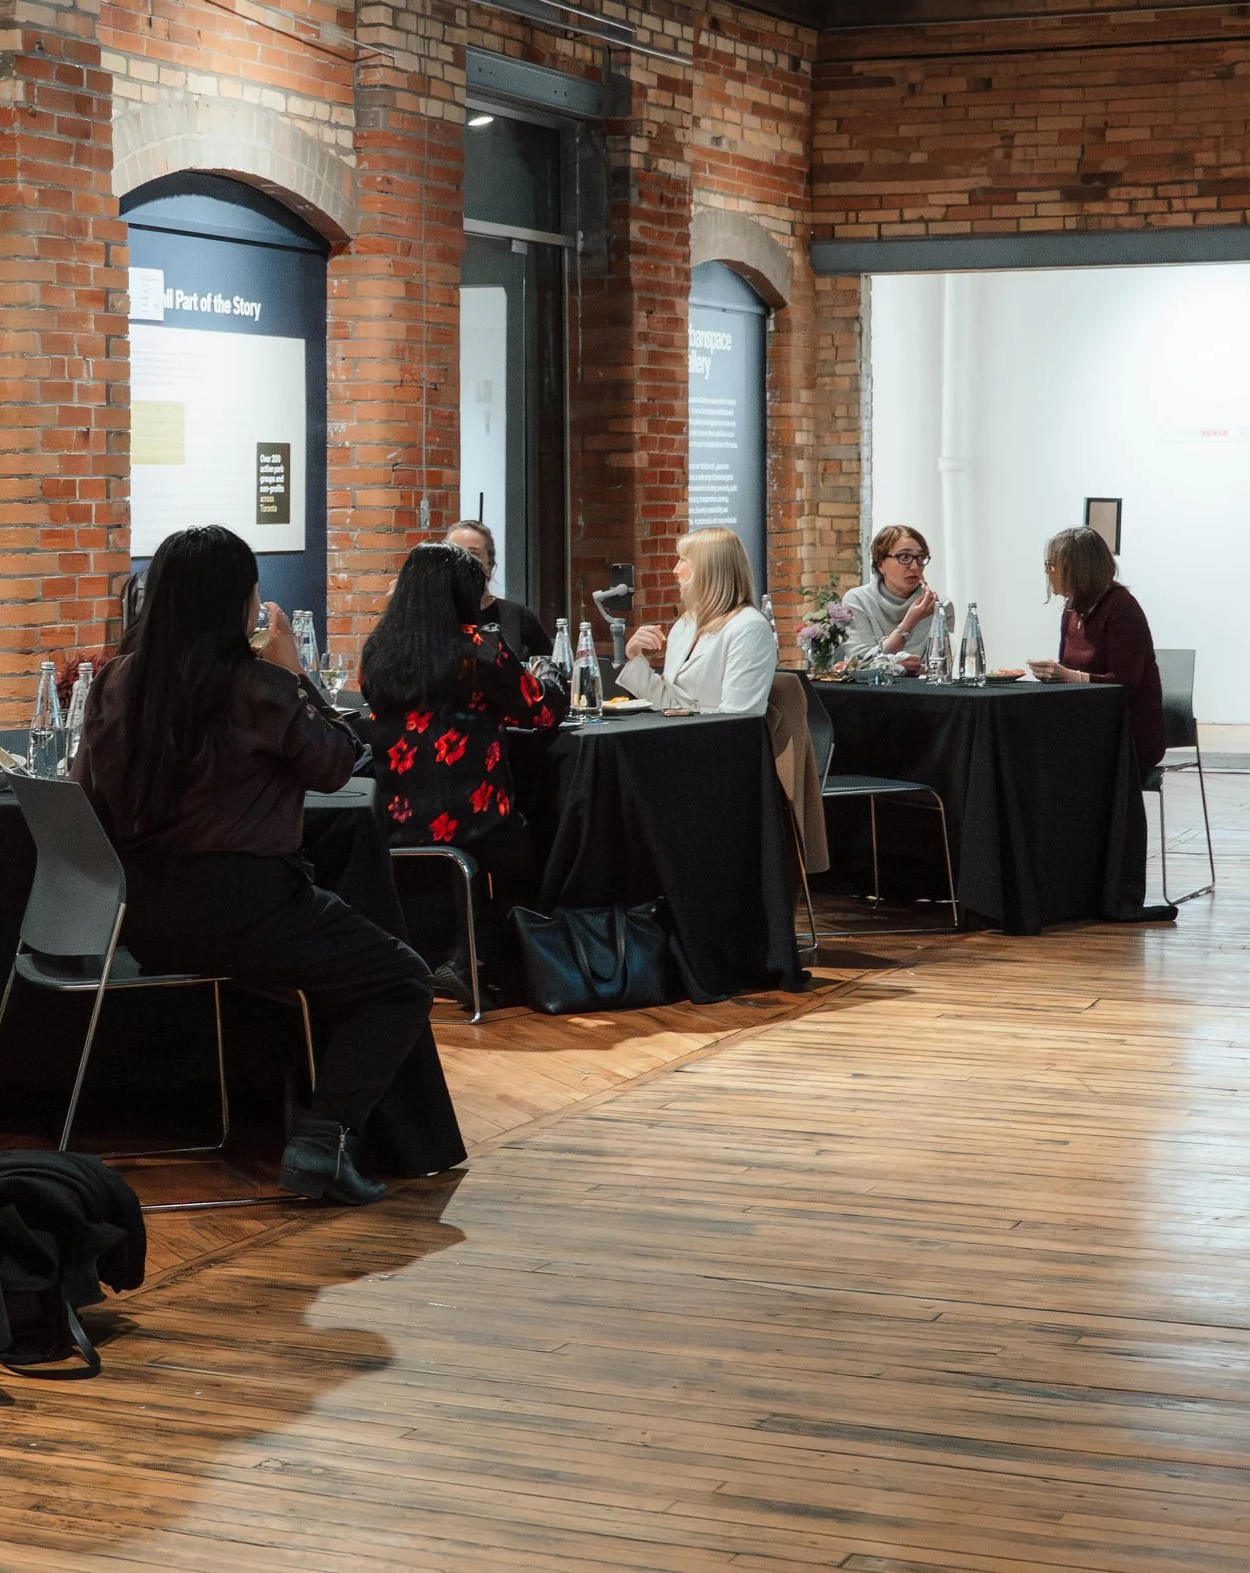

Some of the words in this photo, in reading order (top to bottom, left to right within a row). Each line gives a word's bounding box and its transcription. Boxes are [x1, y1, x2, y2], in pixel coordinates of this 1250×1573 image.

[175, 289, 199, 311] Part
[200, 292, 213, 312] of
[213, 293, 231, 315] the
[233, 295, 261, 321] Story
[688, 322, 732, 355] banspace
